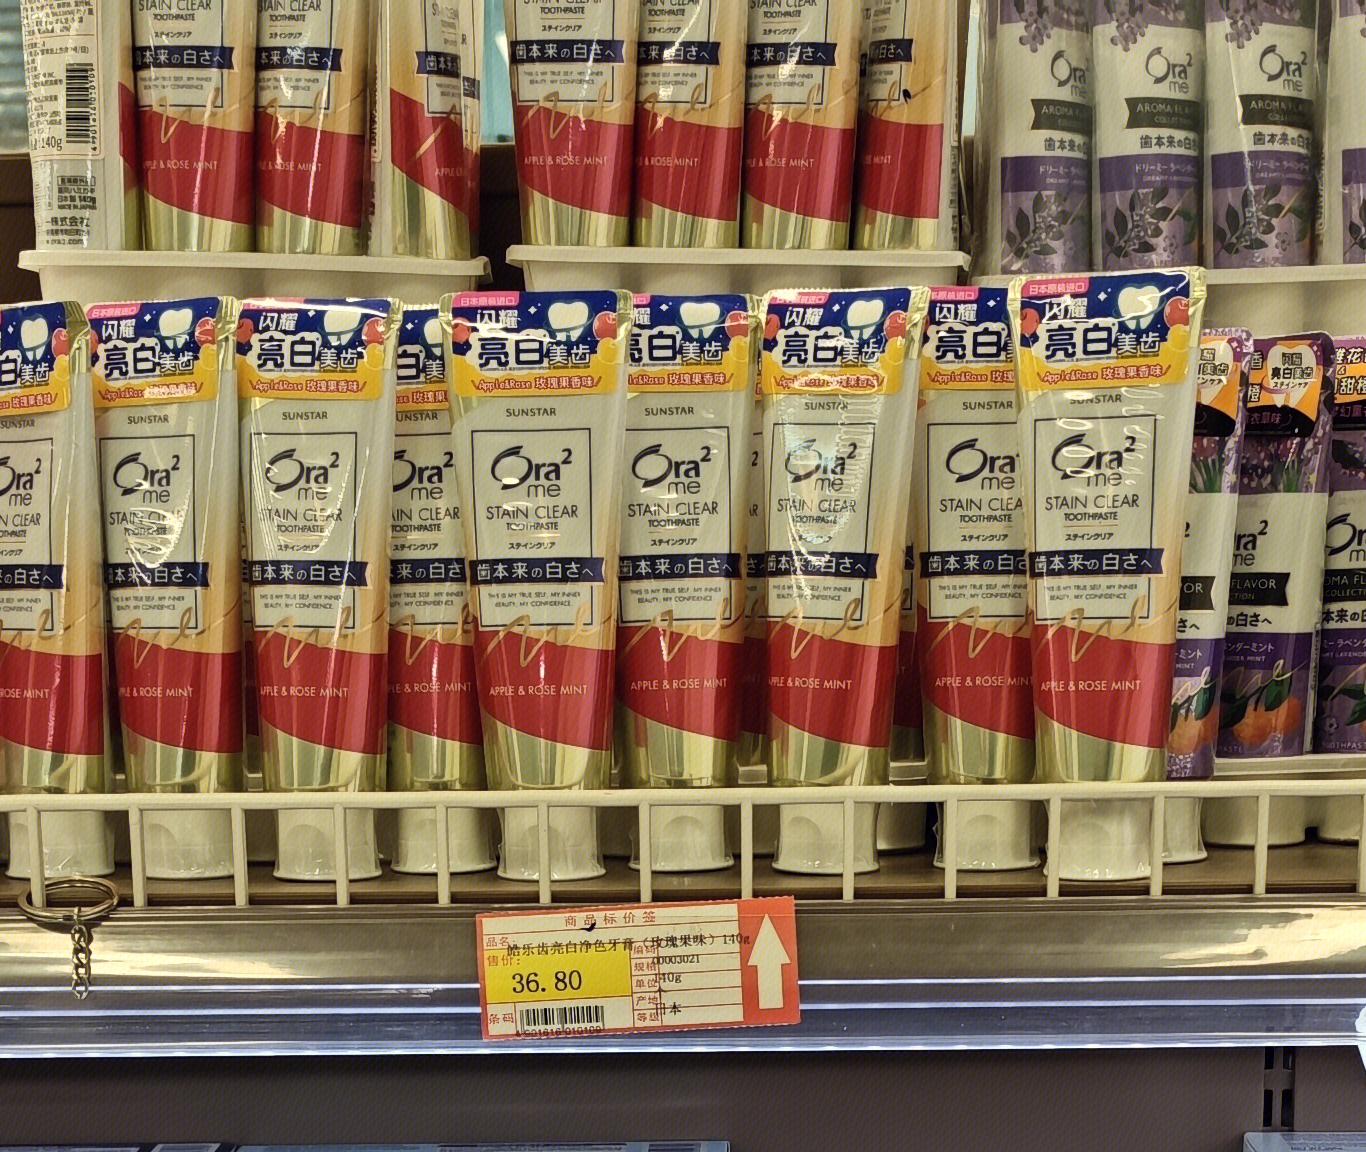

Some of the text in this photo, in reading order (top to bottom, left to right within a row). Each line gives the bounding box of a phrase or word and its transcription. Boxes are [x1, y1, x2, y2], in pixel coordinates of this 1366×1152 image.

[535, 375, 595, 389] 玫瑰果香味
[505, 407, 557, 417] SUNSTAR
[527, 479, 561, 498] me
[485, 505, 578, 520] STAIN CLEAR
[506, 522, 559, 531] TOOTHPASTE
[508, 541, 556, 551] ステインクリア
[477, 560, 595, 581] 歯本来の白さへ
[489, 685, 588, 697] APPLE & ROSE MINT
[512, 970, 582, 993] 36.80
